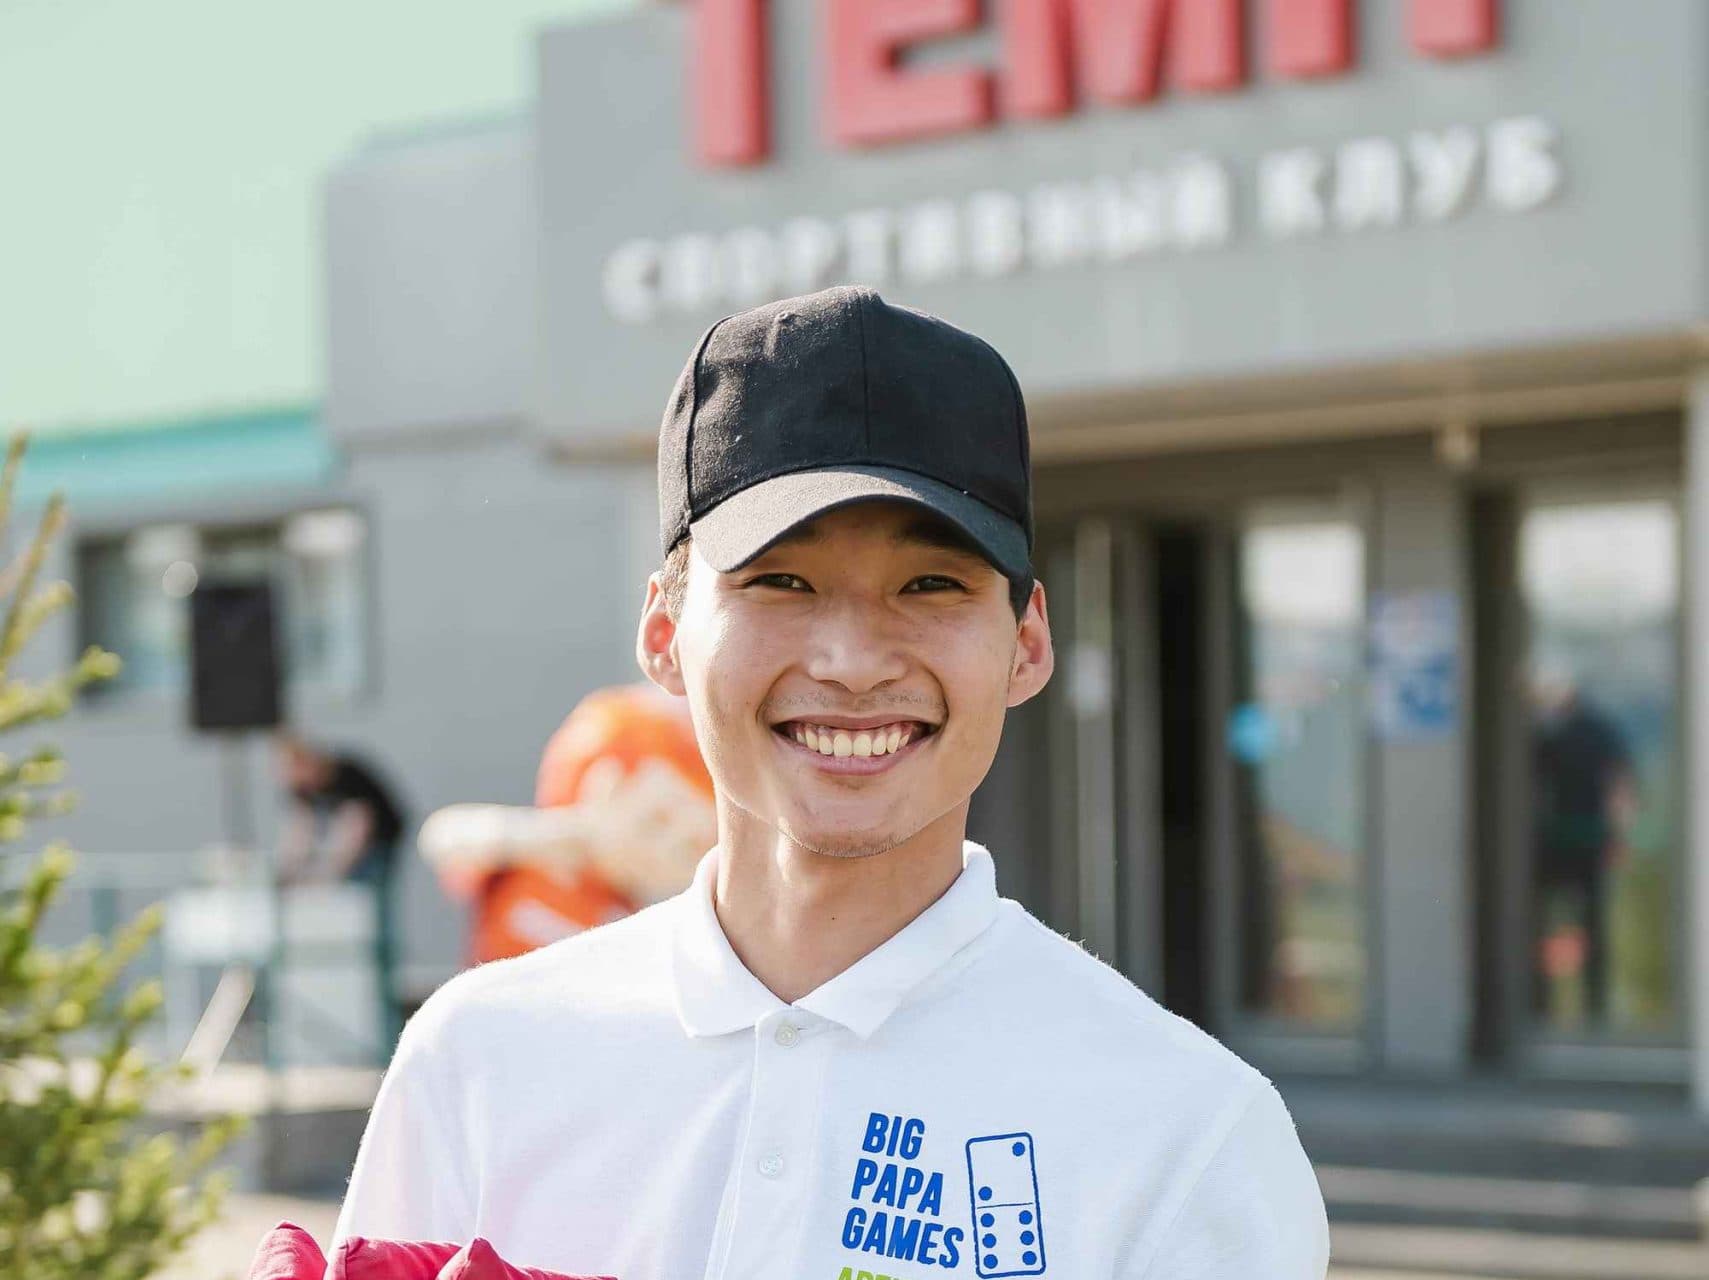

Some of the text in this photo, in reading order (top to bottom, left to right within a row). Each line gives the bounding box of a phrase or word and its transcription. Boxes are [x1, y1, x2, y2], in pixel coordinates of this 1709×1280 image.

[1257, 115, 1563, 242] КЛУБ
[862, 1112, 925, 1160] BIG
[851, 1158, 944, 1216] PAPA
[841, 1207, 964, 1268] GAMES
